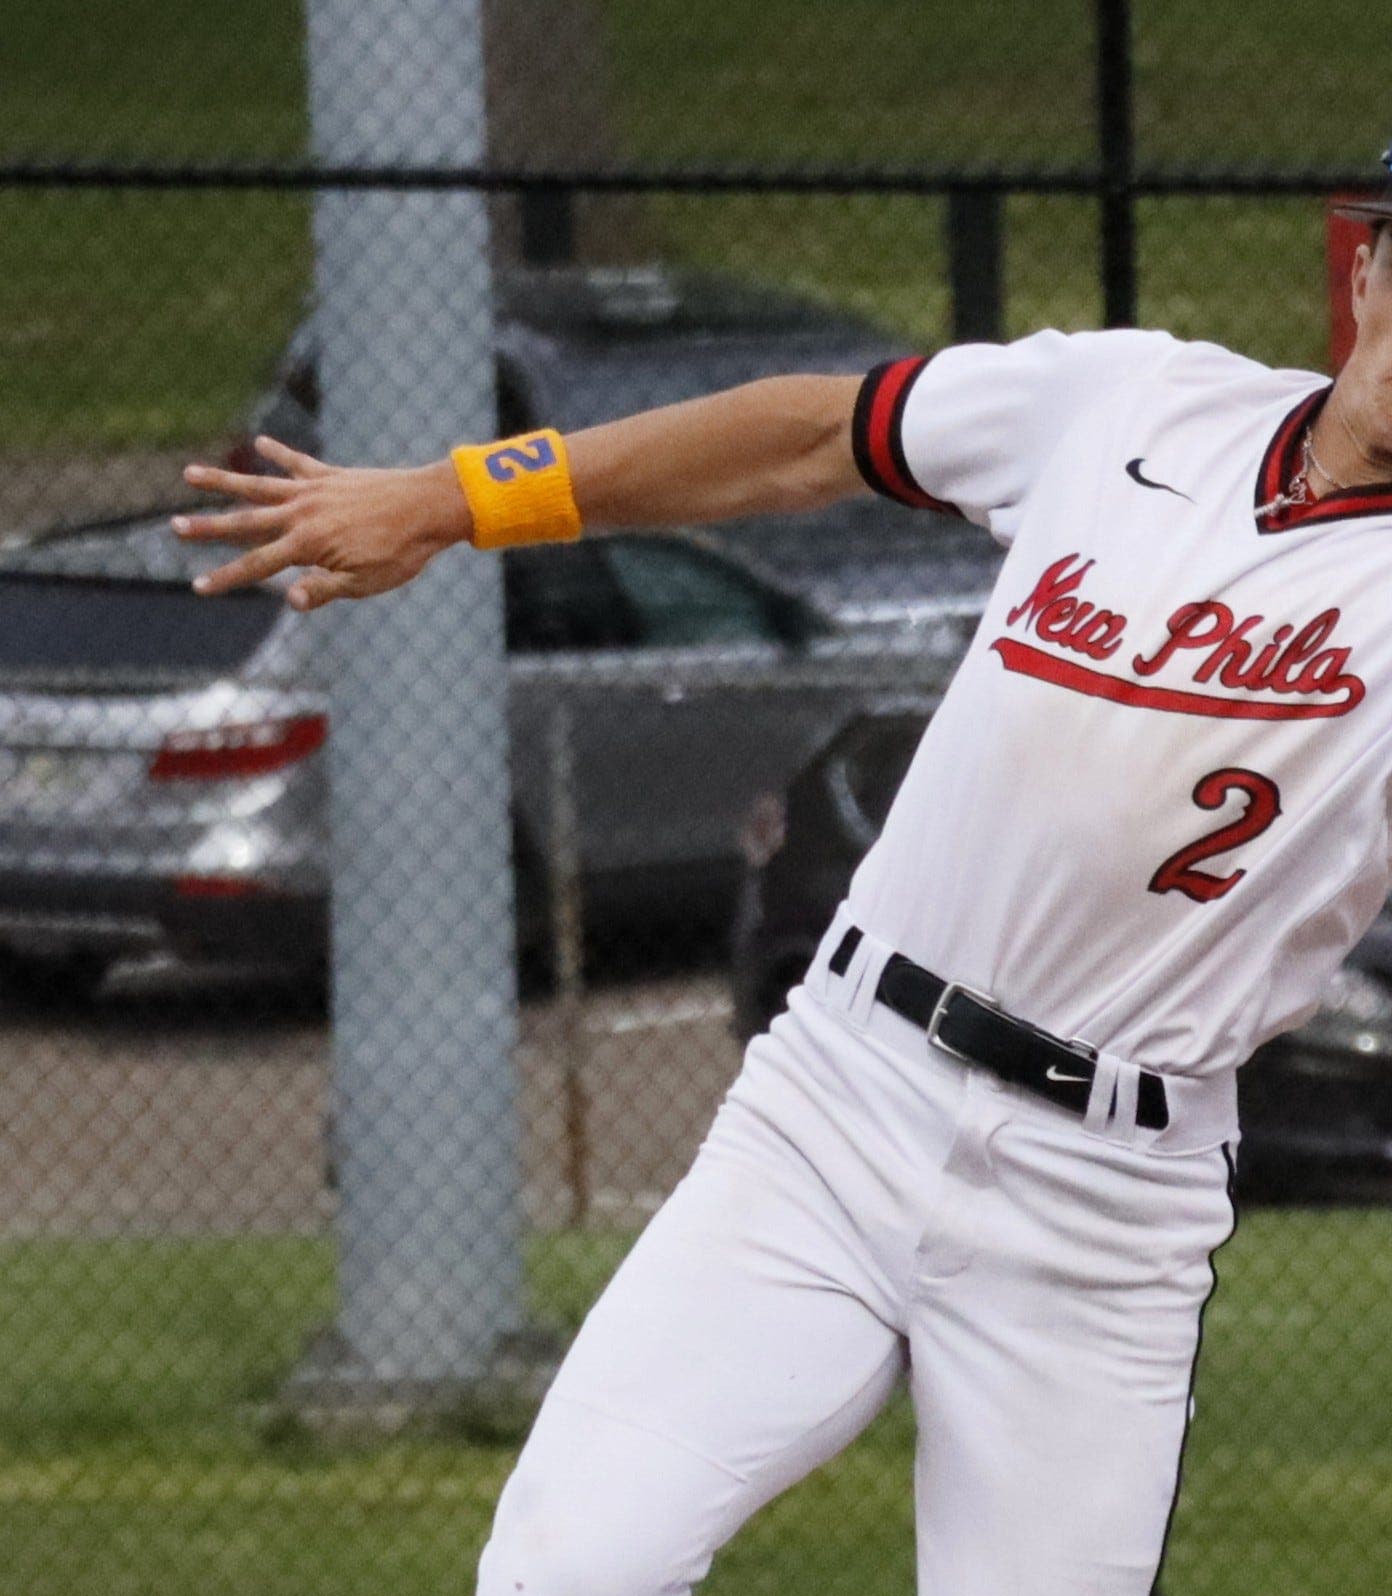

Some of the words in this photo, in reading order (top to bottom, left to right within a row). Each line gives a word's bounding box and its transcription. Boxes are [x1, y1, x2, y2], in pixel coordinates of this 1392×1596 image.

[485, 438, 556, 482] 2
[1006, 553, 1127, 660] New
[1132, 600, 1360, 694] Phila
[1147, 767, 1282, 903] 2
